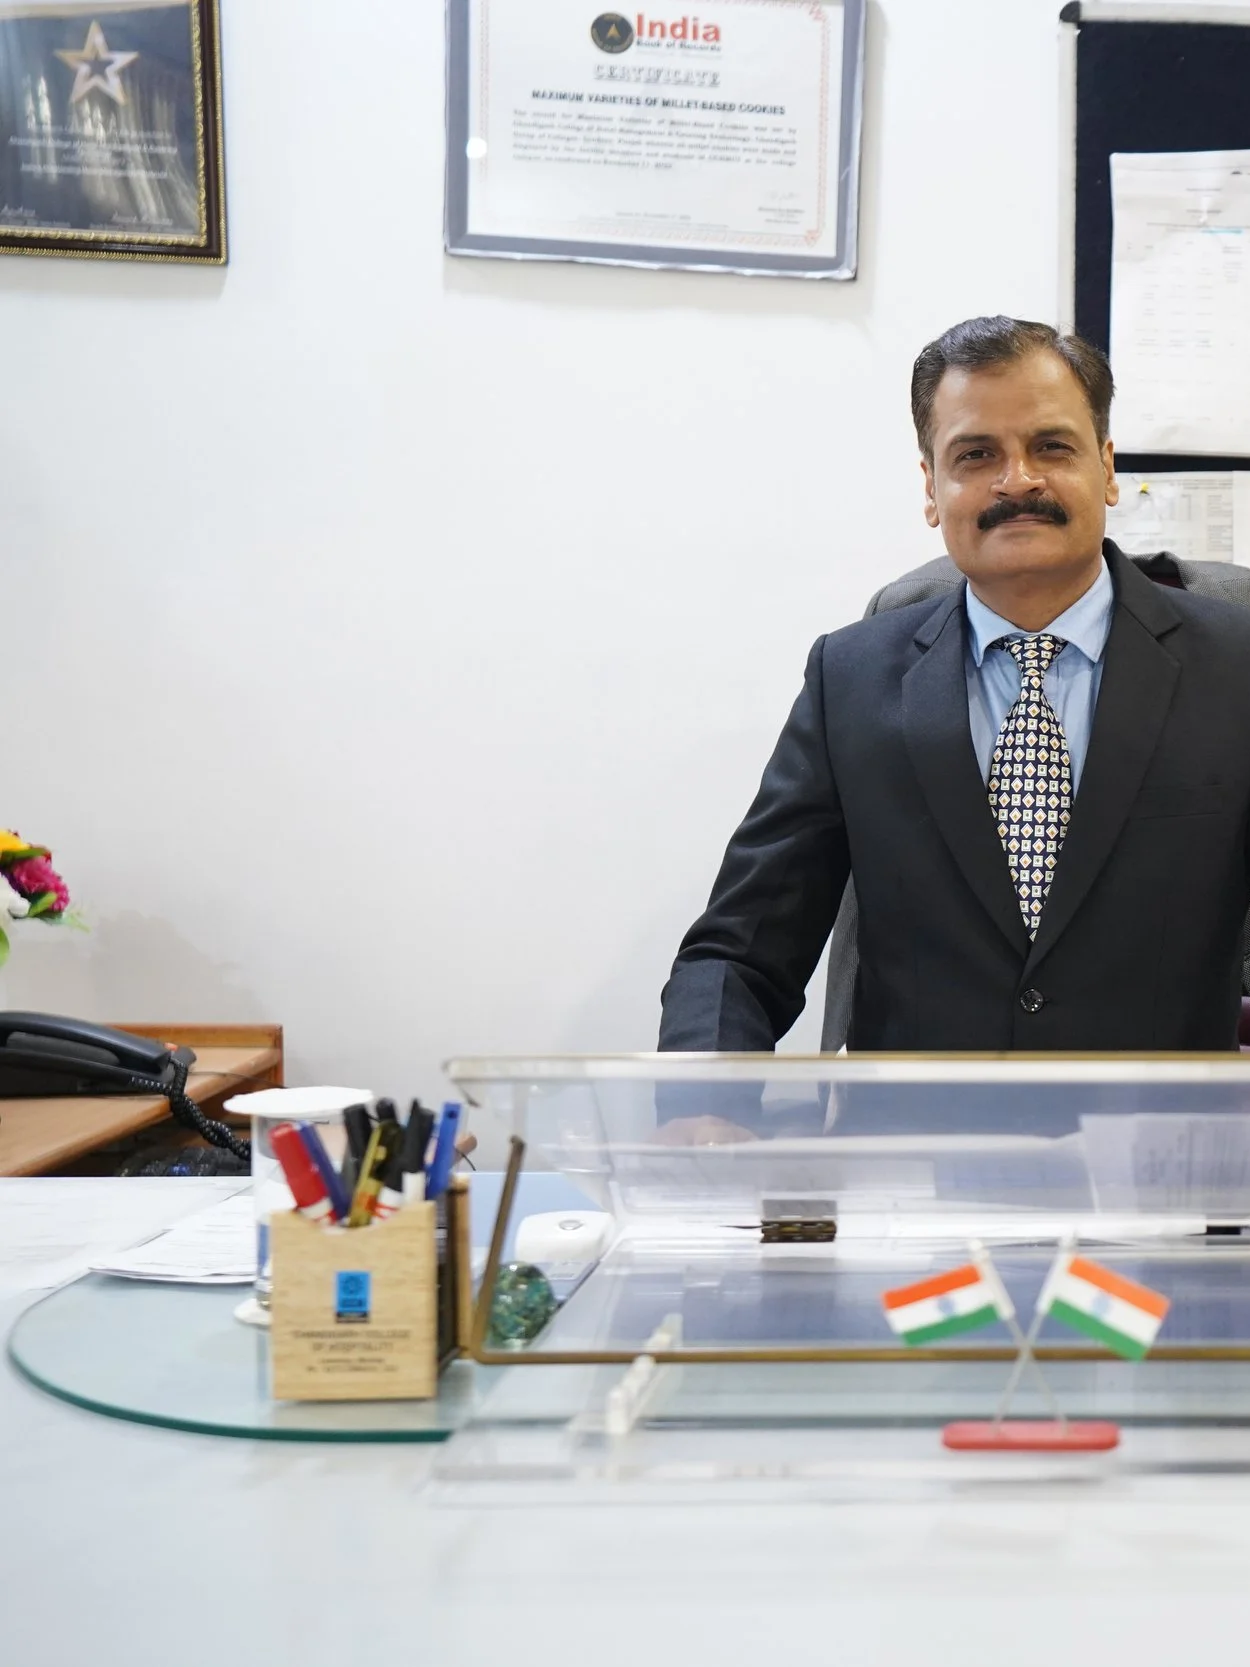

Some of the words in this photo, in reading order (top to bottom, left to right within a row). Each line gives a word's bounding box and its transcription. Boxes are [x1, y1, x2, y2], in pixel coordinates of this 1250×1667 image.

[635, 12, 721, 42] India
[593, 63, 721, 87] CERTIFICATE
[531, 89, 584, 102] MAXIMUM
[588, 93, 642, 106] VARIETIES
[645, 96, 660, 107] OF
[662, 98, 737, 112] MILLET-BASED
[739, 103, 786, 115] COOKIES
